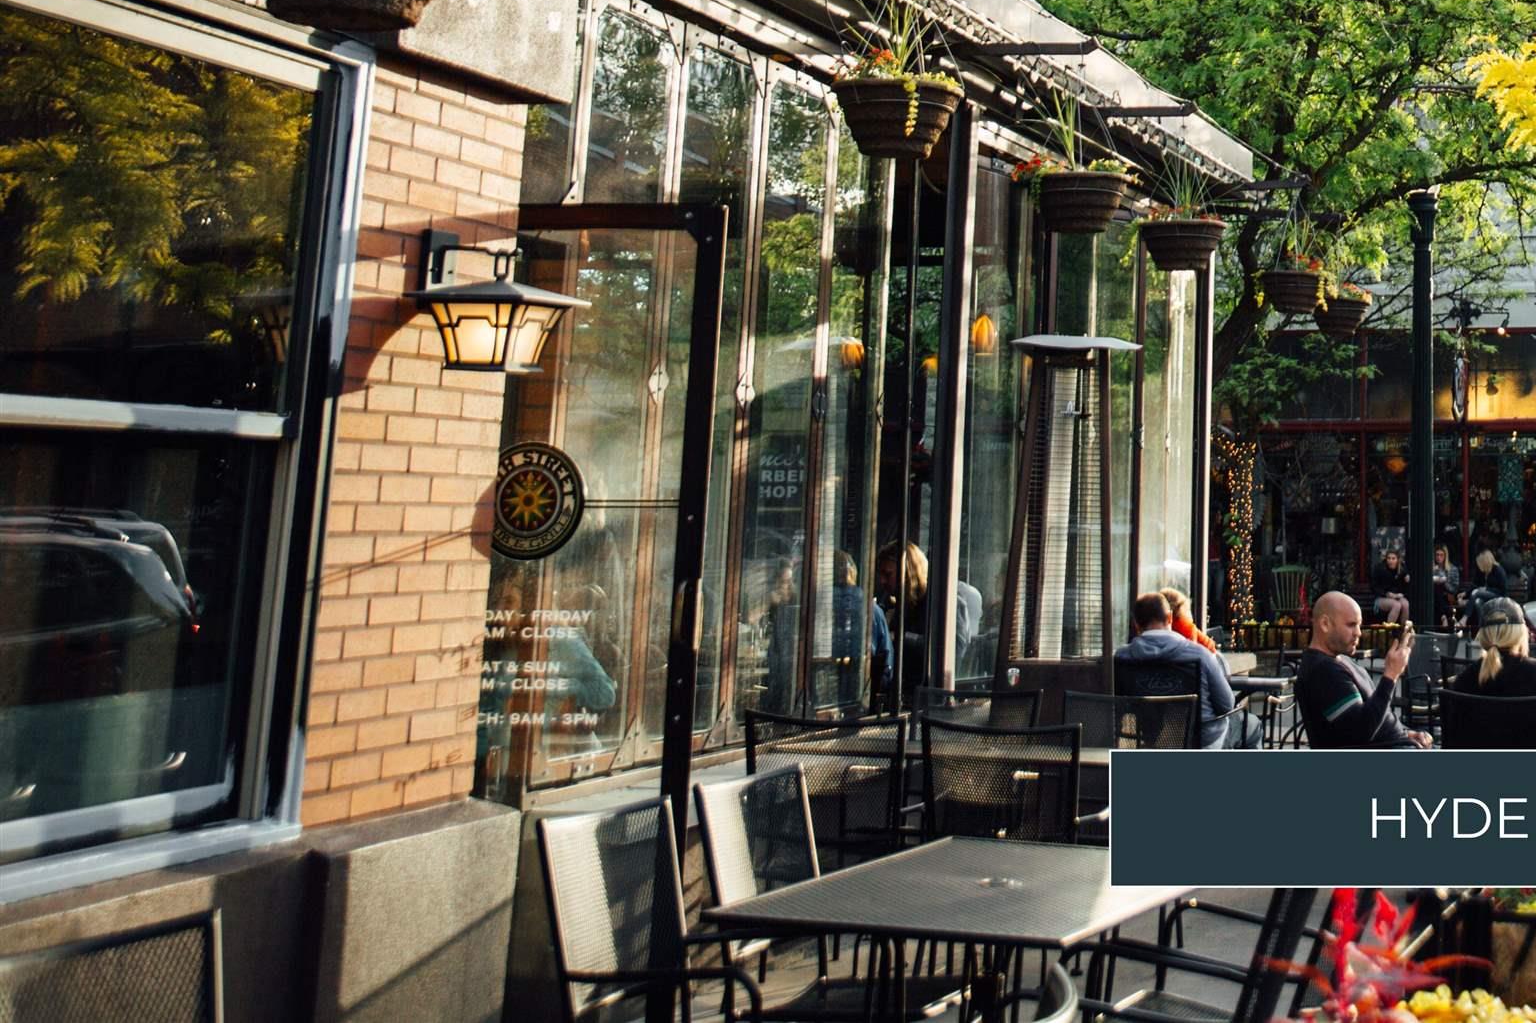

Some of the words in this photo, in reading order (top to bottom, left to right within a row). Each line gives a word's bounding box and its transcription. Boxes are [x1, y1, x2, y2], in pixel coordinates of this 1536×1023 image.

[531, 609, 593, 622] FRIDAY
[521, 627, 580, 639] CLOSE
[507, 661, 518, 673] &
[523, 661, 561, 673] SUN
[512, 678, 570, 690] CLOSE
[509, 712, 546, 725] 9AM
[562, 712, 599, 725] 3PM
